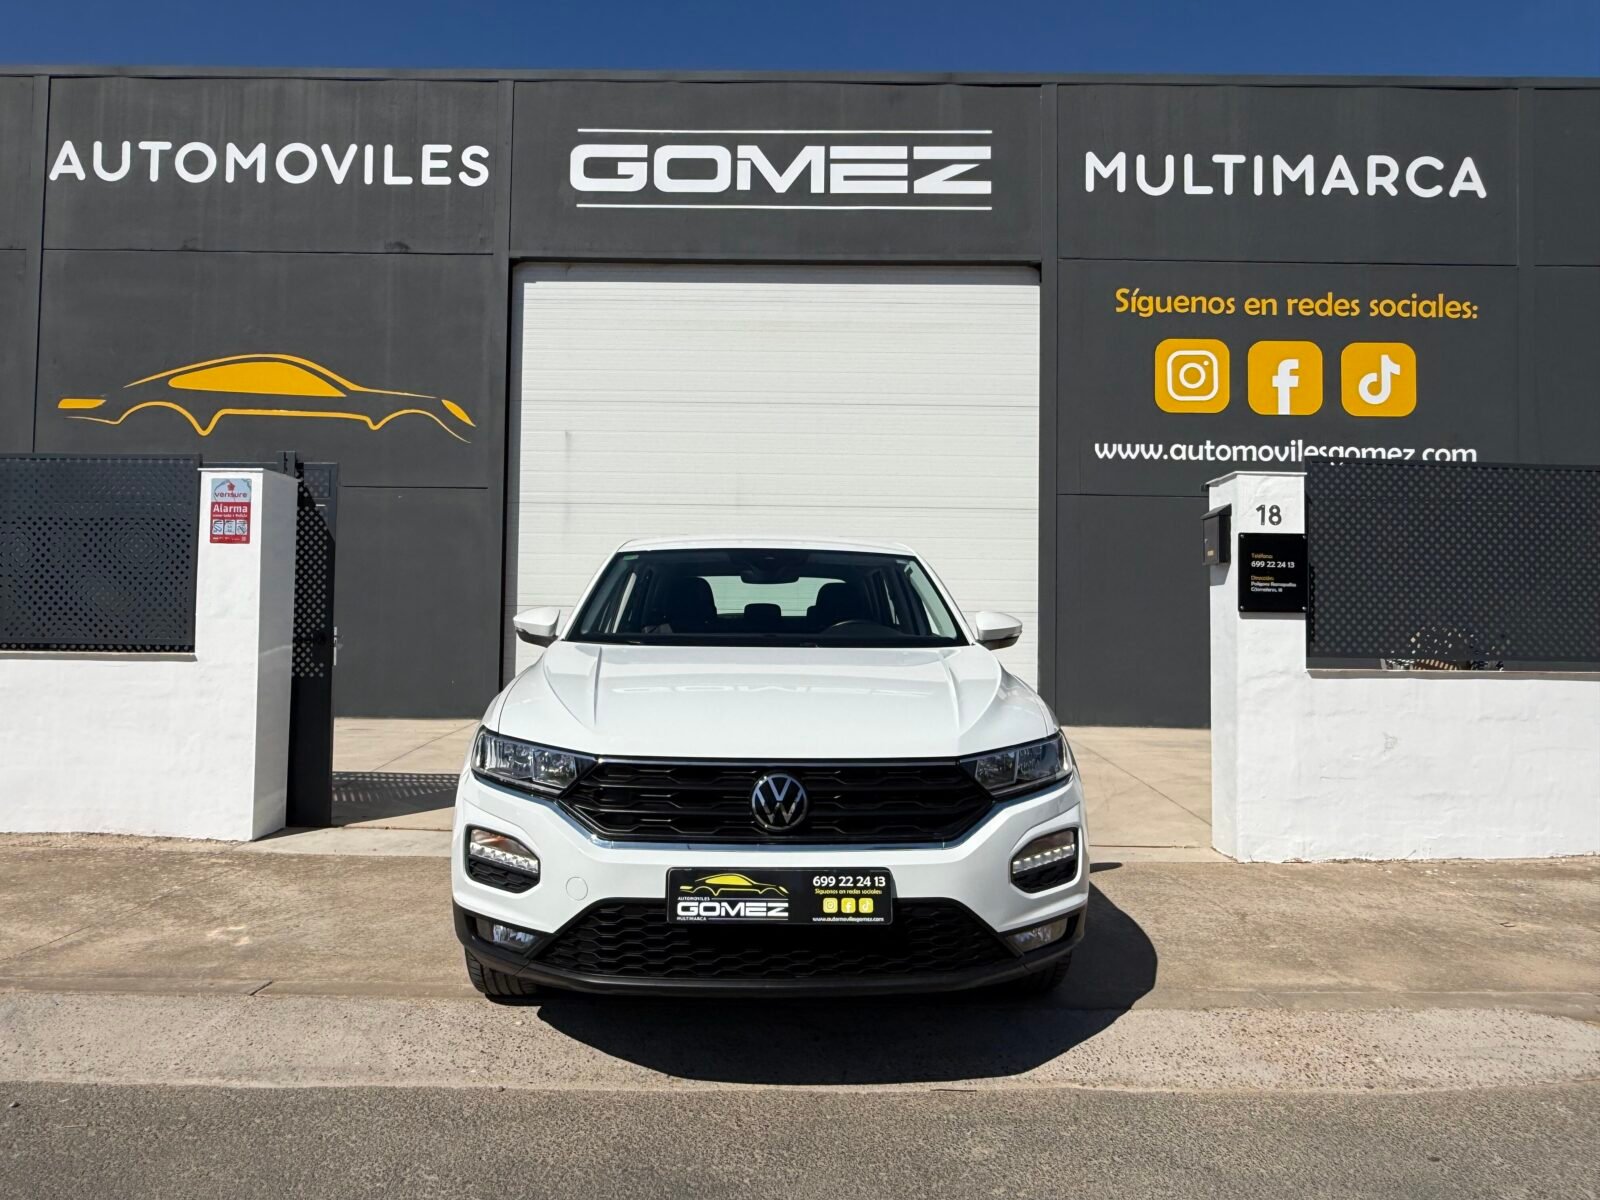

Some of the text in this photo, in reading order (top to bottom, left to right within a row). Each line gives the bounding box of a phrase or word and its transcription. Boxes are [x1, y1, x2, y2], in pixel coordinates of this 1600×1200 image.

[49, 140, 490, 187] AUTOMOVILES
[570, 144, 992, 195] GOMEZ
[1085, 151, 1488, 199] MULTIMARCA
[1115, 287, 1478, 320] Síguenos en redes sociales:
[1094, 440, 1478, 465] www.automovilesgomezcom
[213, 503, 248, 513] Alarma
[1256, 504, 1282, 526] 18
[1251, 560, 1265, 568] 699
[1287, 561, 1295, 569] 13
[812, 876, 886, 887] 699 22 24 13
[676, 901, 789, 917] GOMEZ
